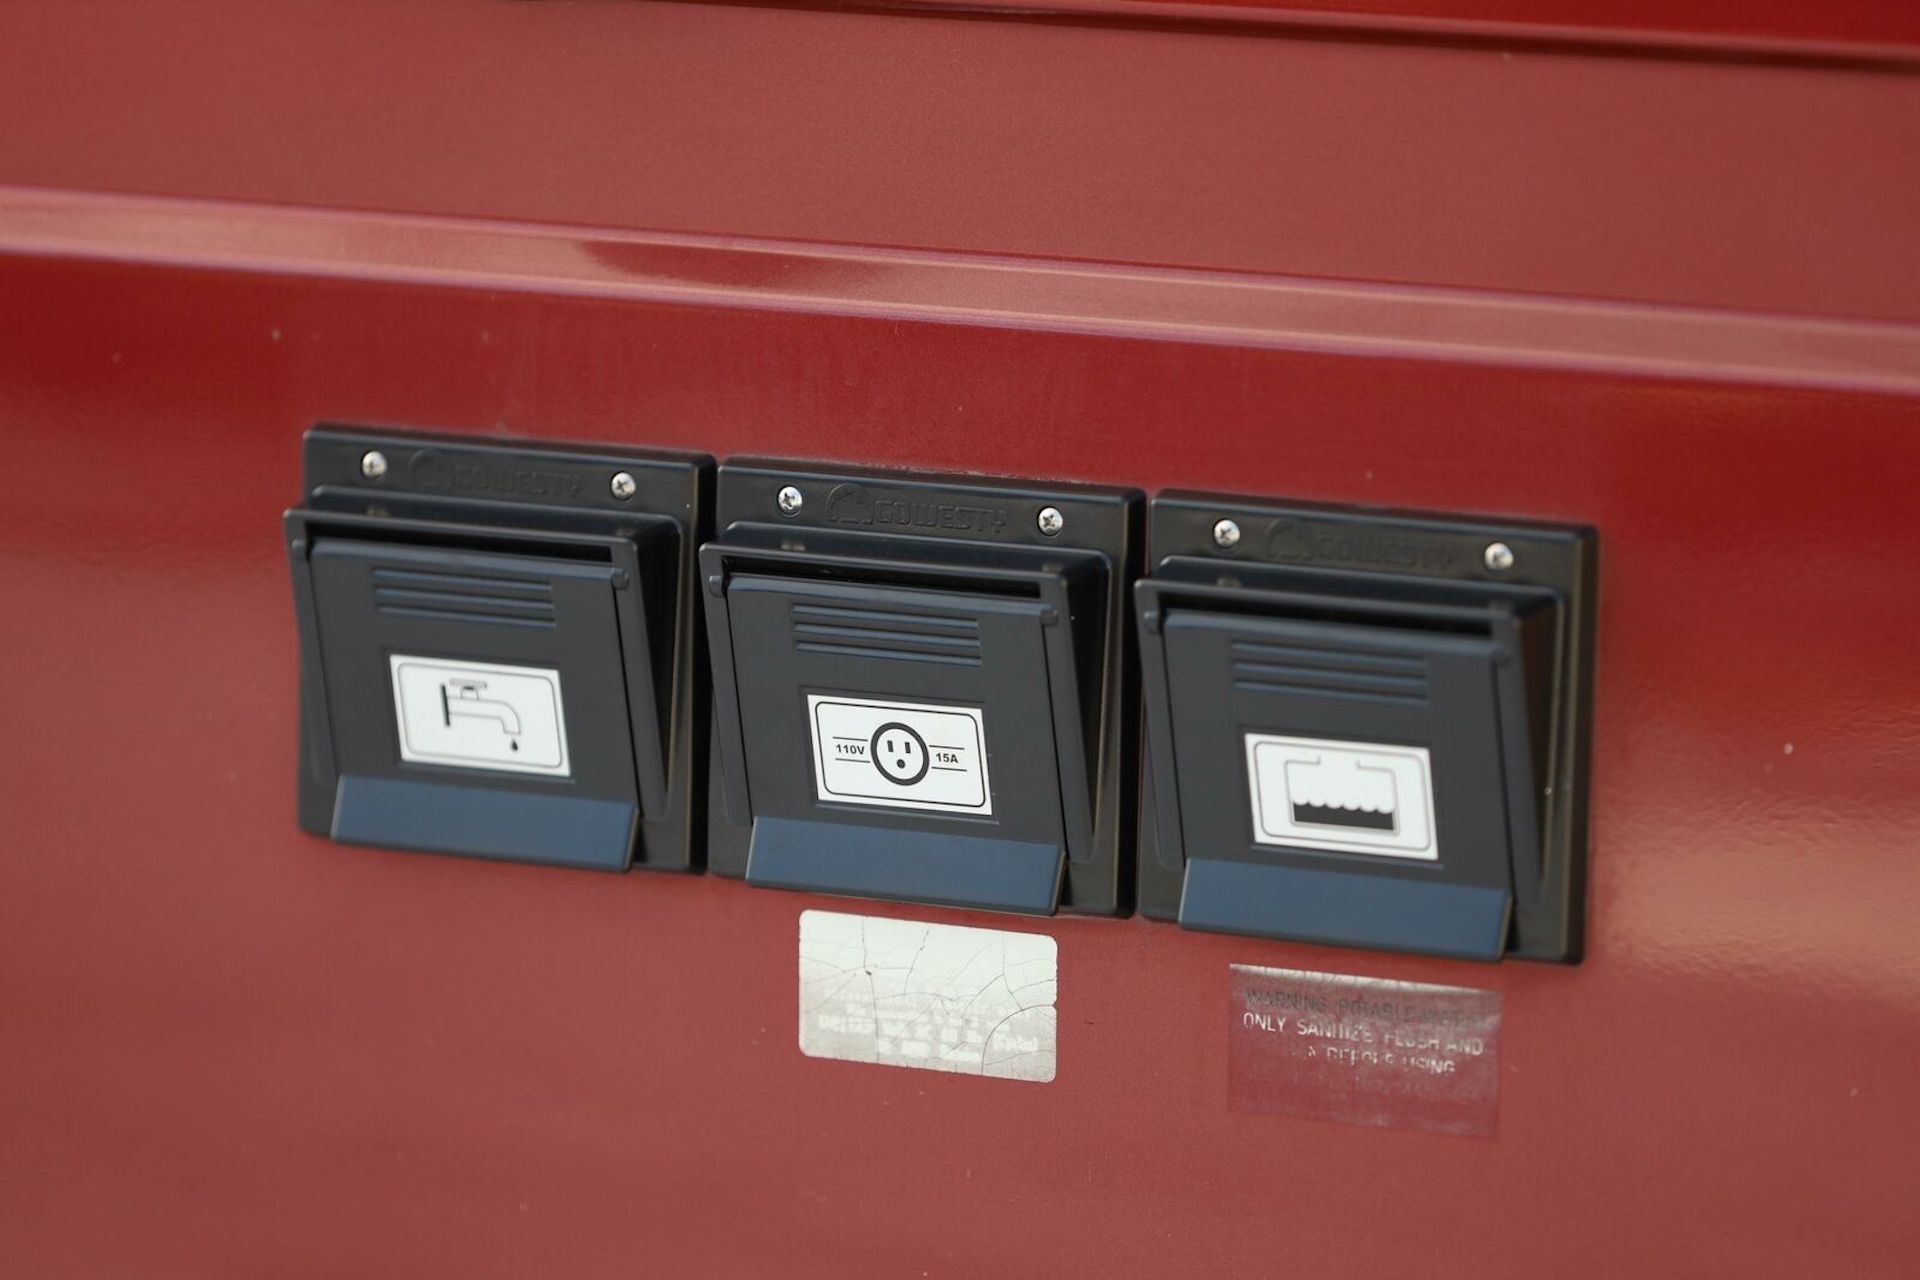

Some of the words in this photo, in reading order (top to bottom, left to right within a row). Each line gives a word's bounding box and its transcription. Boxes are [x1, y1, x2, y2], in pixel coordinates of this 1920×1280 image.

[454, 464, 581, 499] GOWESTY
[874, 499, 1007, 534] GOWESTY
[835, 743, 865, 755] 110V
[935, 752, 959, 764] 15A
[1243, 1012, 1286, 1033] ONLY
[1296, 1018, 1374, 1043] SANITIZE
[1384, 1030, 1440, 1050] FLUSH
[1447, 1035, 1484, 1056] AND
